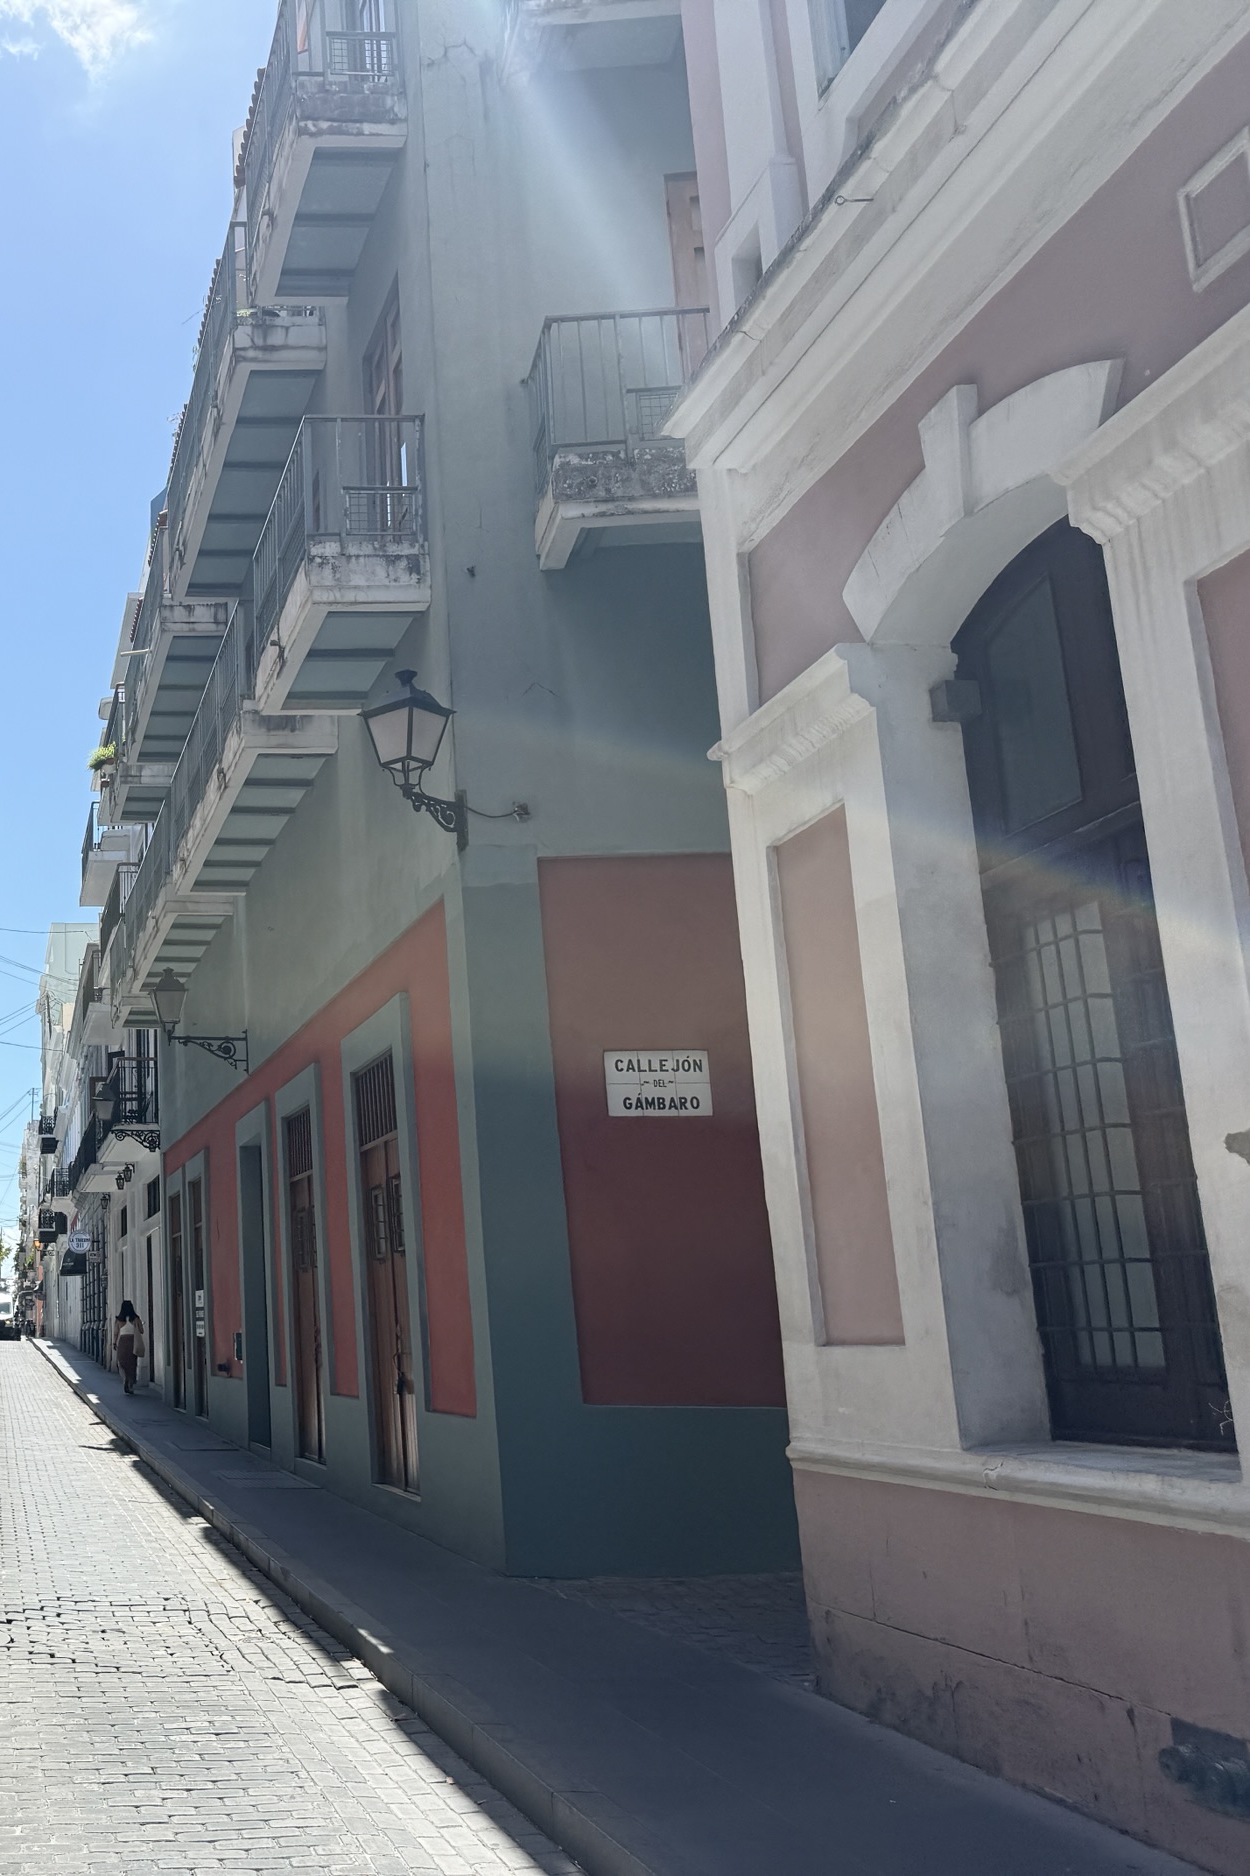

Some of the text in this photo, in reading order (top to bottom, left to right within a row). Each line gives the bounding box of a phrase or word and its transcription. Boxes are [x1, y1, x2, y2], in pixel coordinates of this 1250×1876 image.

[614, 1055, 703, 1073] CALLEJÓN
[653, 1079, 667, 1088] DEL
[623, 1092, 700, 1111] GÁMBARO
